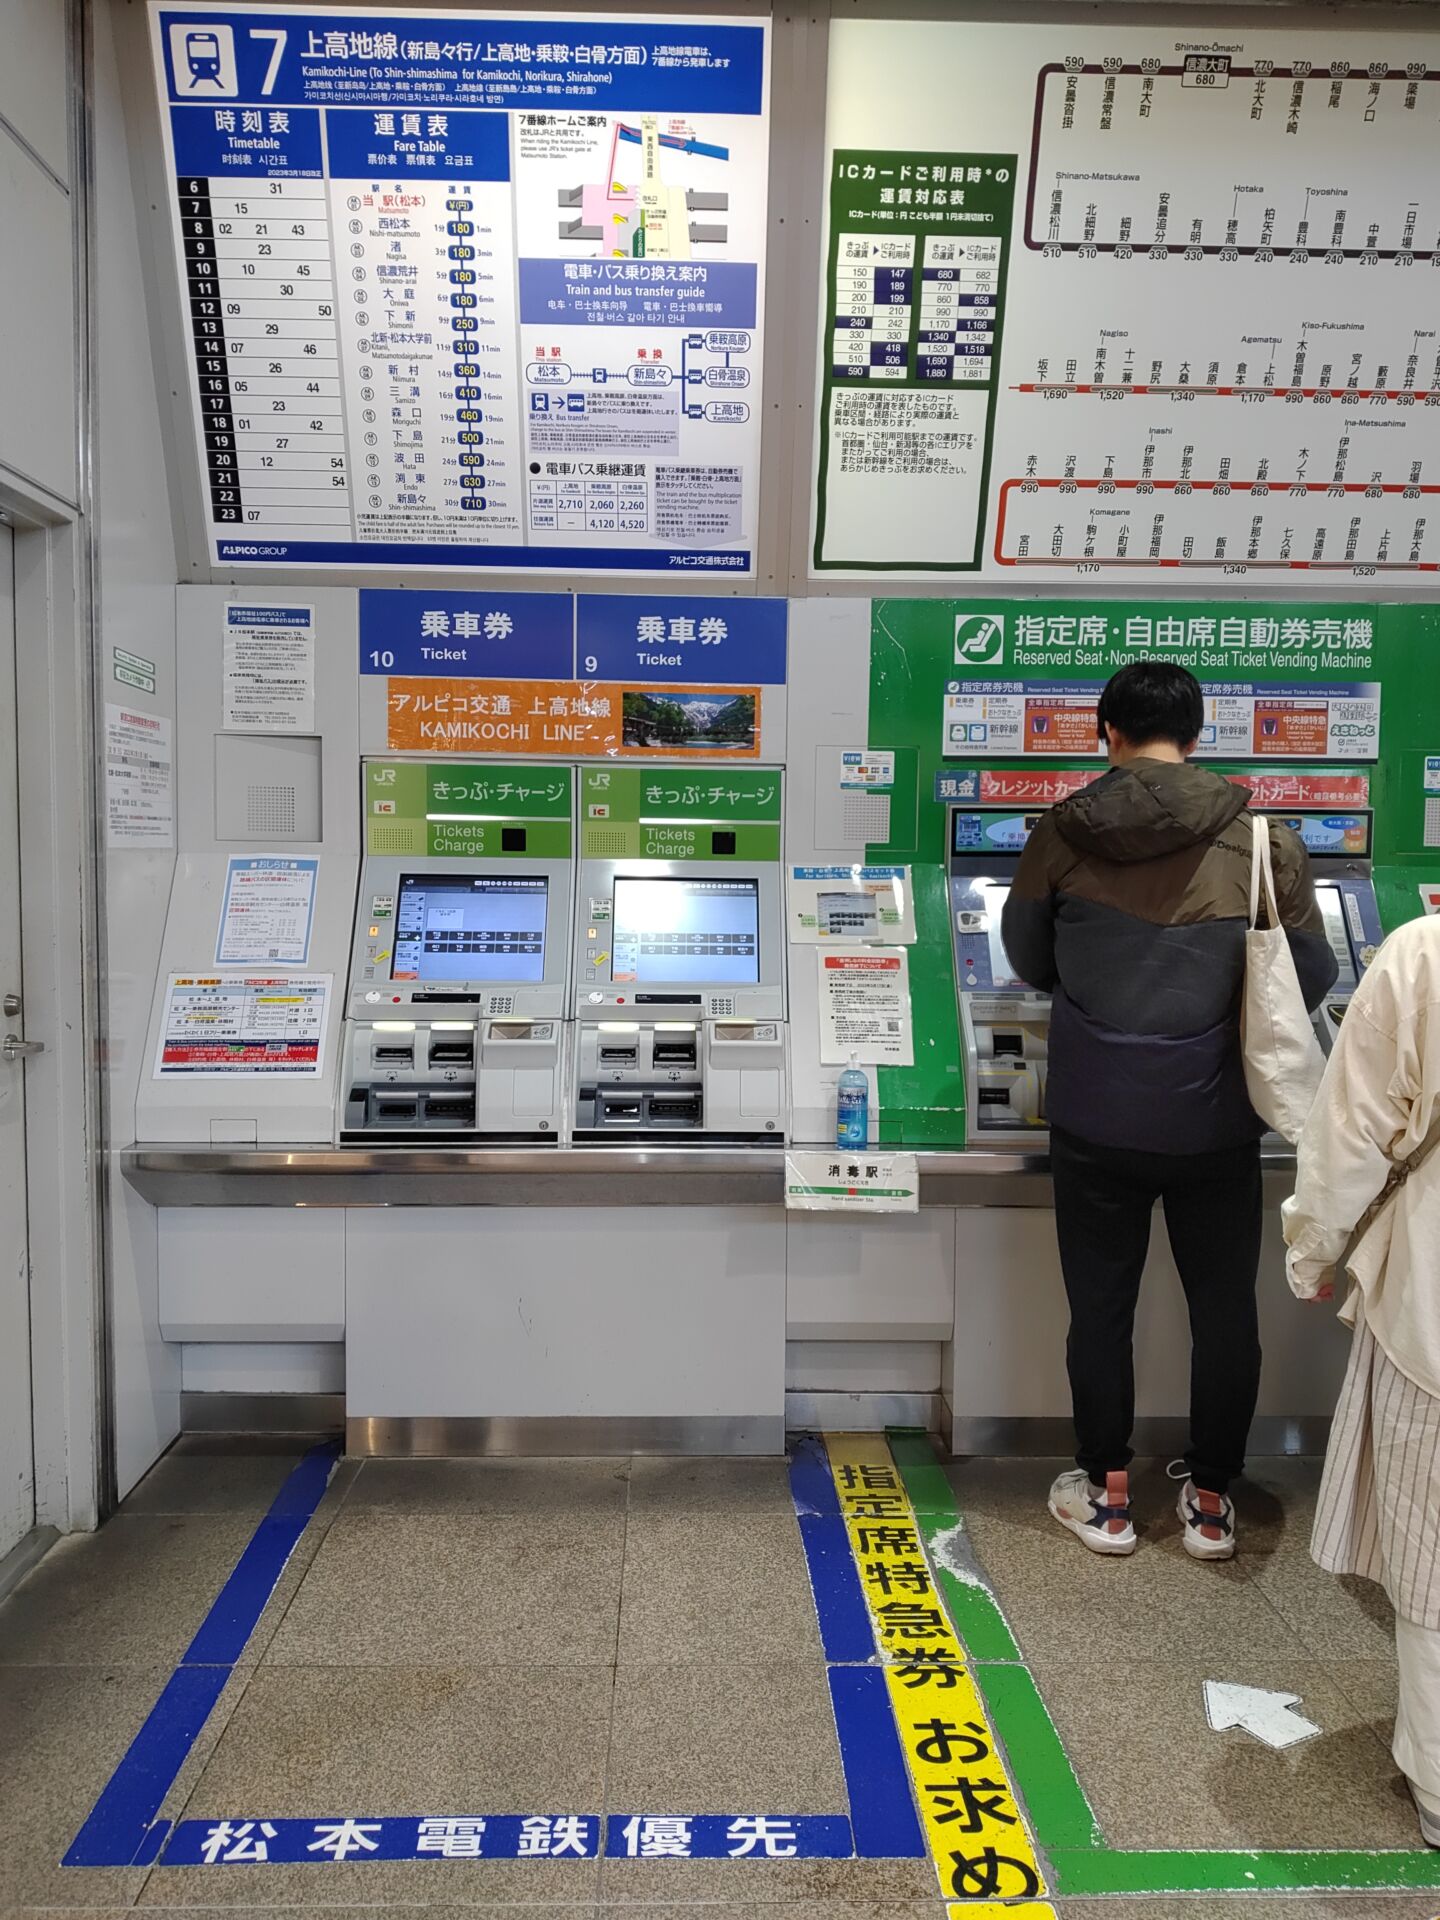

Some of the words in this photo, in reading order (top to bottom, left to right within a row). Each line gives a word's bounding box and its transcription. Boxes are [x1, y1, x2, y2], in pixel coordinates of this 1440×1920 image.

[250, 29, 288, 95] 7
[1065, 57, 1084, 67] 590
[1186, 58, 1229, 72] 信濃大町
[1254, 60, 1274, 70] 770
[1330, 62, 1350, 72] 860
[1407, 63, 1426, 73] 990
[302, 66, 367, 79] Kamikochi-Line
[370, 66, 382, 80] (To
[384, 67, 457, 79] Shin-shimashima
[462, 68, 474, 79] for
[476, 69, 522, 82] Kamikochi,
[525, 70, 564, 83] Norikura,
[567, 71, 612, 84] Shirahone)
[1139, 78, 1154, 117] 南大町
[1250, 80, 1266, 120] 北大町
[1364, 82, 1380, 122] 海ノ口
[215, 111, 290, 134] 時刻表
[373, 114, 449, 137] 運賃表
[518, 115, 607, 127] 7番線ホームご案内
[228, 137, 280, 150] Timetable
[394, 141, 416, 152] Fare
[419, 141, 446, 153] Table
[259, 155, 288, 166] 시간표
[444, 155, 474, 166] 요금표
[1055, 172, 1140, 181] Shinano-Matsukawa
[190, 181, 199, 193] 6
[270, 183, 282, 194] 31
[880, 188, 965, 206] 運賃対応表
[191, 202, 200, 213] 7
[235, 203, 248, 214] 15
[1048, 190, 1062, 240] 信濃松川
[194, 222, 203, 234] 8
[219, 223, 232, 234] 02
[256, 224, 268, 235] 21
[292, 225, 305, 236] 43
[378, 218, 411, 229] 西松本
[1042, 248, 1061, 258] 510
[196, 263, 211, 274] 10
[242, 264, 255, 275] 10
[297, 265, 310, 276] 45
[564, 263, 707, 282] 電車・バス乗り換え案内
[853, 269, 867, 277] 150
[890, 269, 905, 278] 147
[937, 271, 953, 279] 680
[976, 271, 991, 280] 682
[198, 283, 212, 294] 11
[280, 285, 294, 295] 30
[566, 284, 590, 295] Train
[593, 285, 611, 296] and
[614, 285, 632, 296] bus
[636, 286, 674, 297] transfer
[677, 287, 705, 299] guide
[890, 282, 905, 290] 189
[200, 303, 215, 314] 12
[227, 304, 240, 314] 09
[318, 305, 331, 316] 50
[456, 319, 473, 329] 250
[850, 318, 866, 327] 240
[887, 319, 903, 328] 242
[929, 320, 950, 329] 1,170
[966, 321, 987, 330] 1,166
[1301, 322, 1364, 331] Kiso-Fukushima
[709, 333, 747, 346] 乗鞍高原
[457, 343, 474, 352] 310
[388, 364, 419, 376] 新村
[458, 366, 475, 375] 360
[537, 365, 561, 377] 松本
[634, 367, 666, 380] 新島々
[708, 369, 746, 381] 白骨温泉
[459, 389, 476, 398] 410
[1042, 390, 1067, 400] 1,690
[391, 407, 422, 418] 森口
[461, 411, 478, 420] 460
[710, 403, 744, 416] 上高地
[393, 430, 423, 442] 下島
[462, 433, 478, 443] 500
[216, 454, 230, 465] 20
[261, 456, 273, 467] 12
[331, 458, 344, 468] 54
[1142, 445, 1155, 479] 伊那市
[1333, 437, 1350, 482] 伊那松島
[546, 462, 646, 477] 電車バス乗継運賃
[397, 493, 427, 505] 新島々
[465, 499, 482, 509] 710
[558, 499, 583, 510] 2,710
[589, 500, 614, 511] 2,060
[620, 501, 645, 511] 2,260
[221, 509, 236, 519] 23
[248, 511, 260, 521] 07
[1089, 508, 1131, 517] Komagane
[590, 519, 615, 529] 4,120
[620, 519, 645, 530] 4,520
[1116, 524, 1129, 558] 小町屋
[222, 546, 258, 554] ALPICO
[258, 547, 287, 555] GROUP
[668, 555, 745, 567] アルピコ交通株式会社
[1076, 563, 1100, 574] 1,170
[420, 611, 514, 639] 乗車券
[636, 616, 729, 645] 乗車券
[1014, 615, 1374, 650] 指定席・自由席自動券売機
[369, 651, 394, 668] 10
[421, 648, 467, 661] Ticket
[636, 653, 682, 666] Ticket
[1013, 650, 1071, 665] Reserved
[1201, 651, 1228, 668] Seat
[1231, 652, 1266, 668] Ticket
[1270, 653, 1317, 672] Vending
[1321, 654, 1373, 669] Machine
[585, 656, 598, 673] 9
[961, 682, 1024, 693] 指定席券売機
[393, 693, 512, 716] アルピコ交通
[528, 697, 611, 718] 上高地線
[420, 722, 530, 741] KAMIKOCHI
[543, 726, 585, 742] LINE
[990, 724, 1019, 734] 新幹線
[1219, 726, 1248, 735] 新幹線
[1331, 725, 1375, 737] えきねっと
[373, 769, 396, 784] JR
[588, 773, 611, 787] JR
[432, 780, 565, 802] きっぷ・チャージ
[940, 779, 974, 796] 現金
[646, 785, 775, 807] きっぷ・チャージ
[434, 824, 484, 838] Tickets
[646, 828, 695, 841] Tickets
[434, 839, 484, 854] Charge
[646, 842, 695, 857] Charge
[258, 860, 290, 869] おしらせ
[828, 1165, 879, 1179] 消毒駅
[838, 1464, 966, 1689] 指定席特急券
[914, 1717, 1041, 1907] お求め
[201, 1814, 799, 1861] 松本電鉄優先
